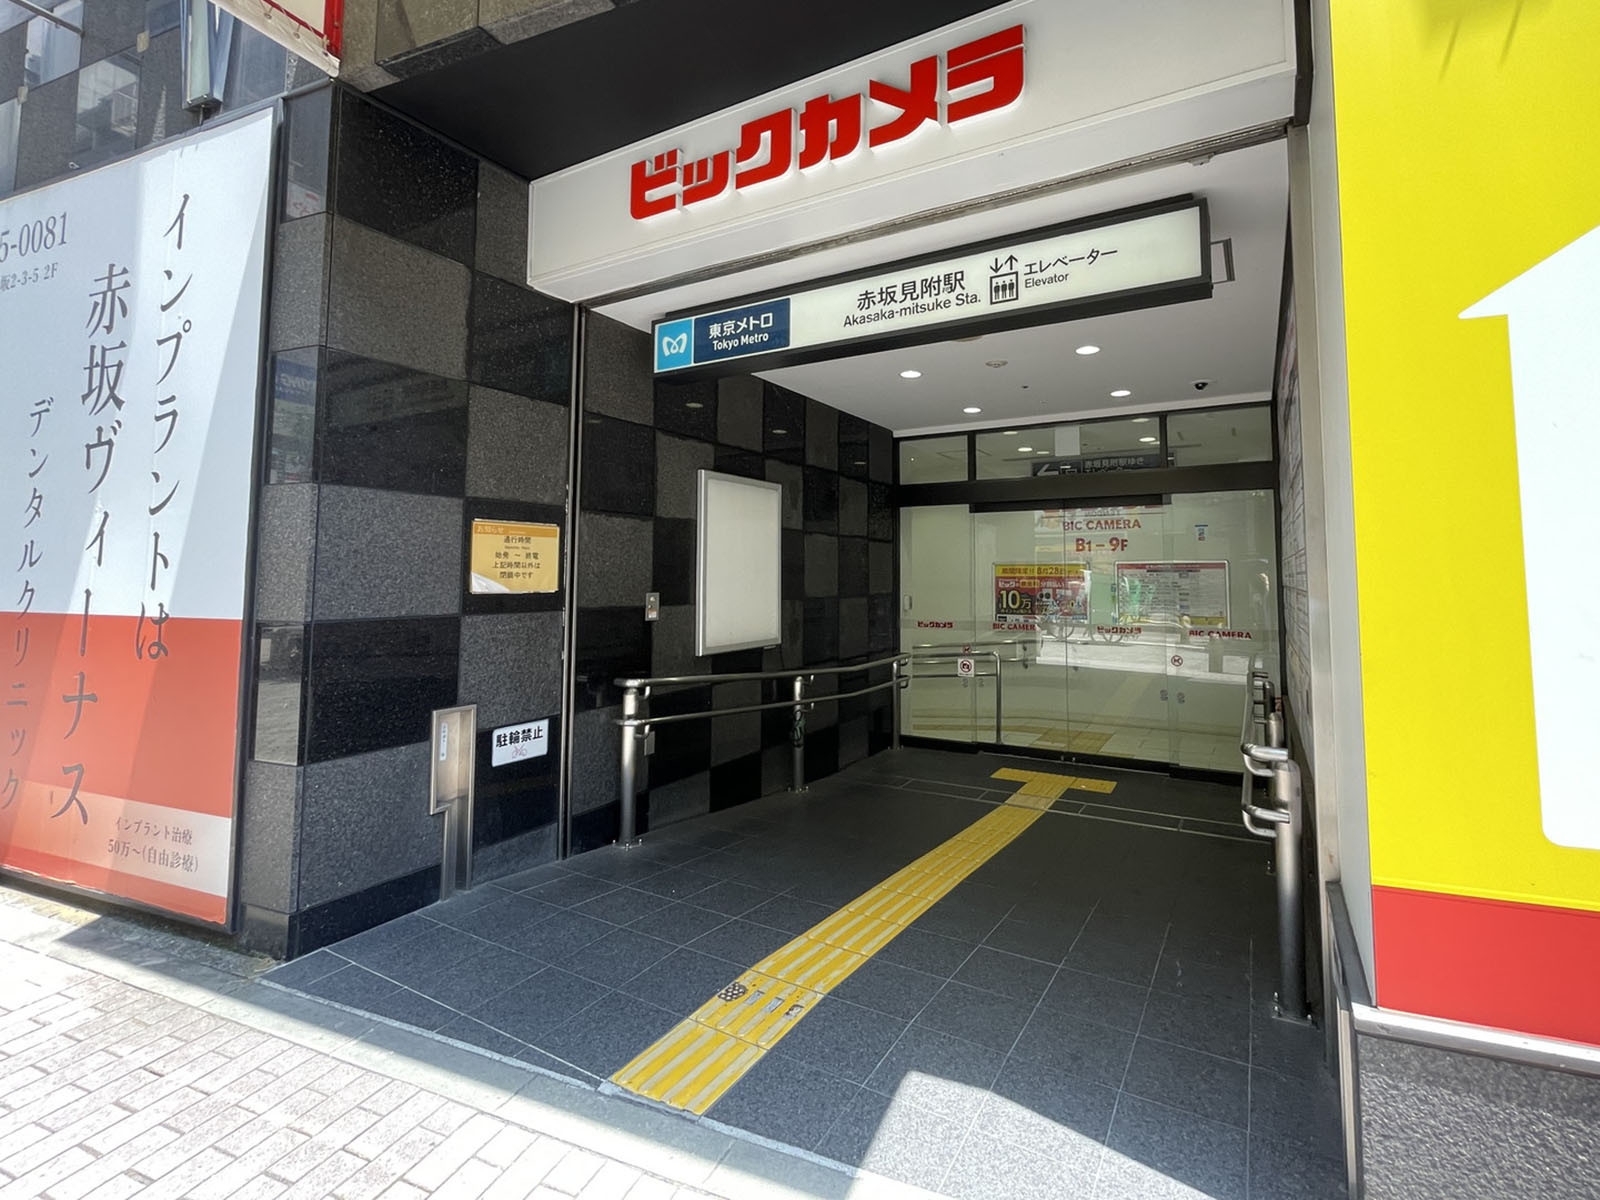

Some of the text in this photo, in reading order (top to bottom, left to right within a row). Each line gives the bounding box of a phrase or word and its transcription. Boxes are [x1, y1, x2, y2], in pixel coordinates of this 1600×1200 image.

[630, 24, 1025, 220] ビックカメラ
[43, 261, 58, 279] 2F
[1024, 248, 1118, 276] エレベーター
[857, 270, 966, 312] 赤坂見附駅
[1024, 271, 1070, 289] Elevator
[843, 292, 981, 328] Akasaka-mitsuke Sta.
[708, 312, 774, 340] 東京メトロ
[712, 332, 769, 351] Tokyo Metro
[136, 193, 193, 660] インプラントは
[1063, 519, 1142, 531] BIC CAMERA
[51, 263, 131, 825] 赤坂ヴィーナス
[0, 396, 54, 811] デンタルクリニック
[1007, 623, 1037, 632] CAMER
[1207, 630, 1252, 640] CAMERA
[496, 726, 544, 748] 駐輪禁止
[116, 817, 193, 846] インプラント治療
